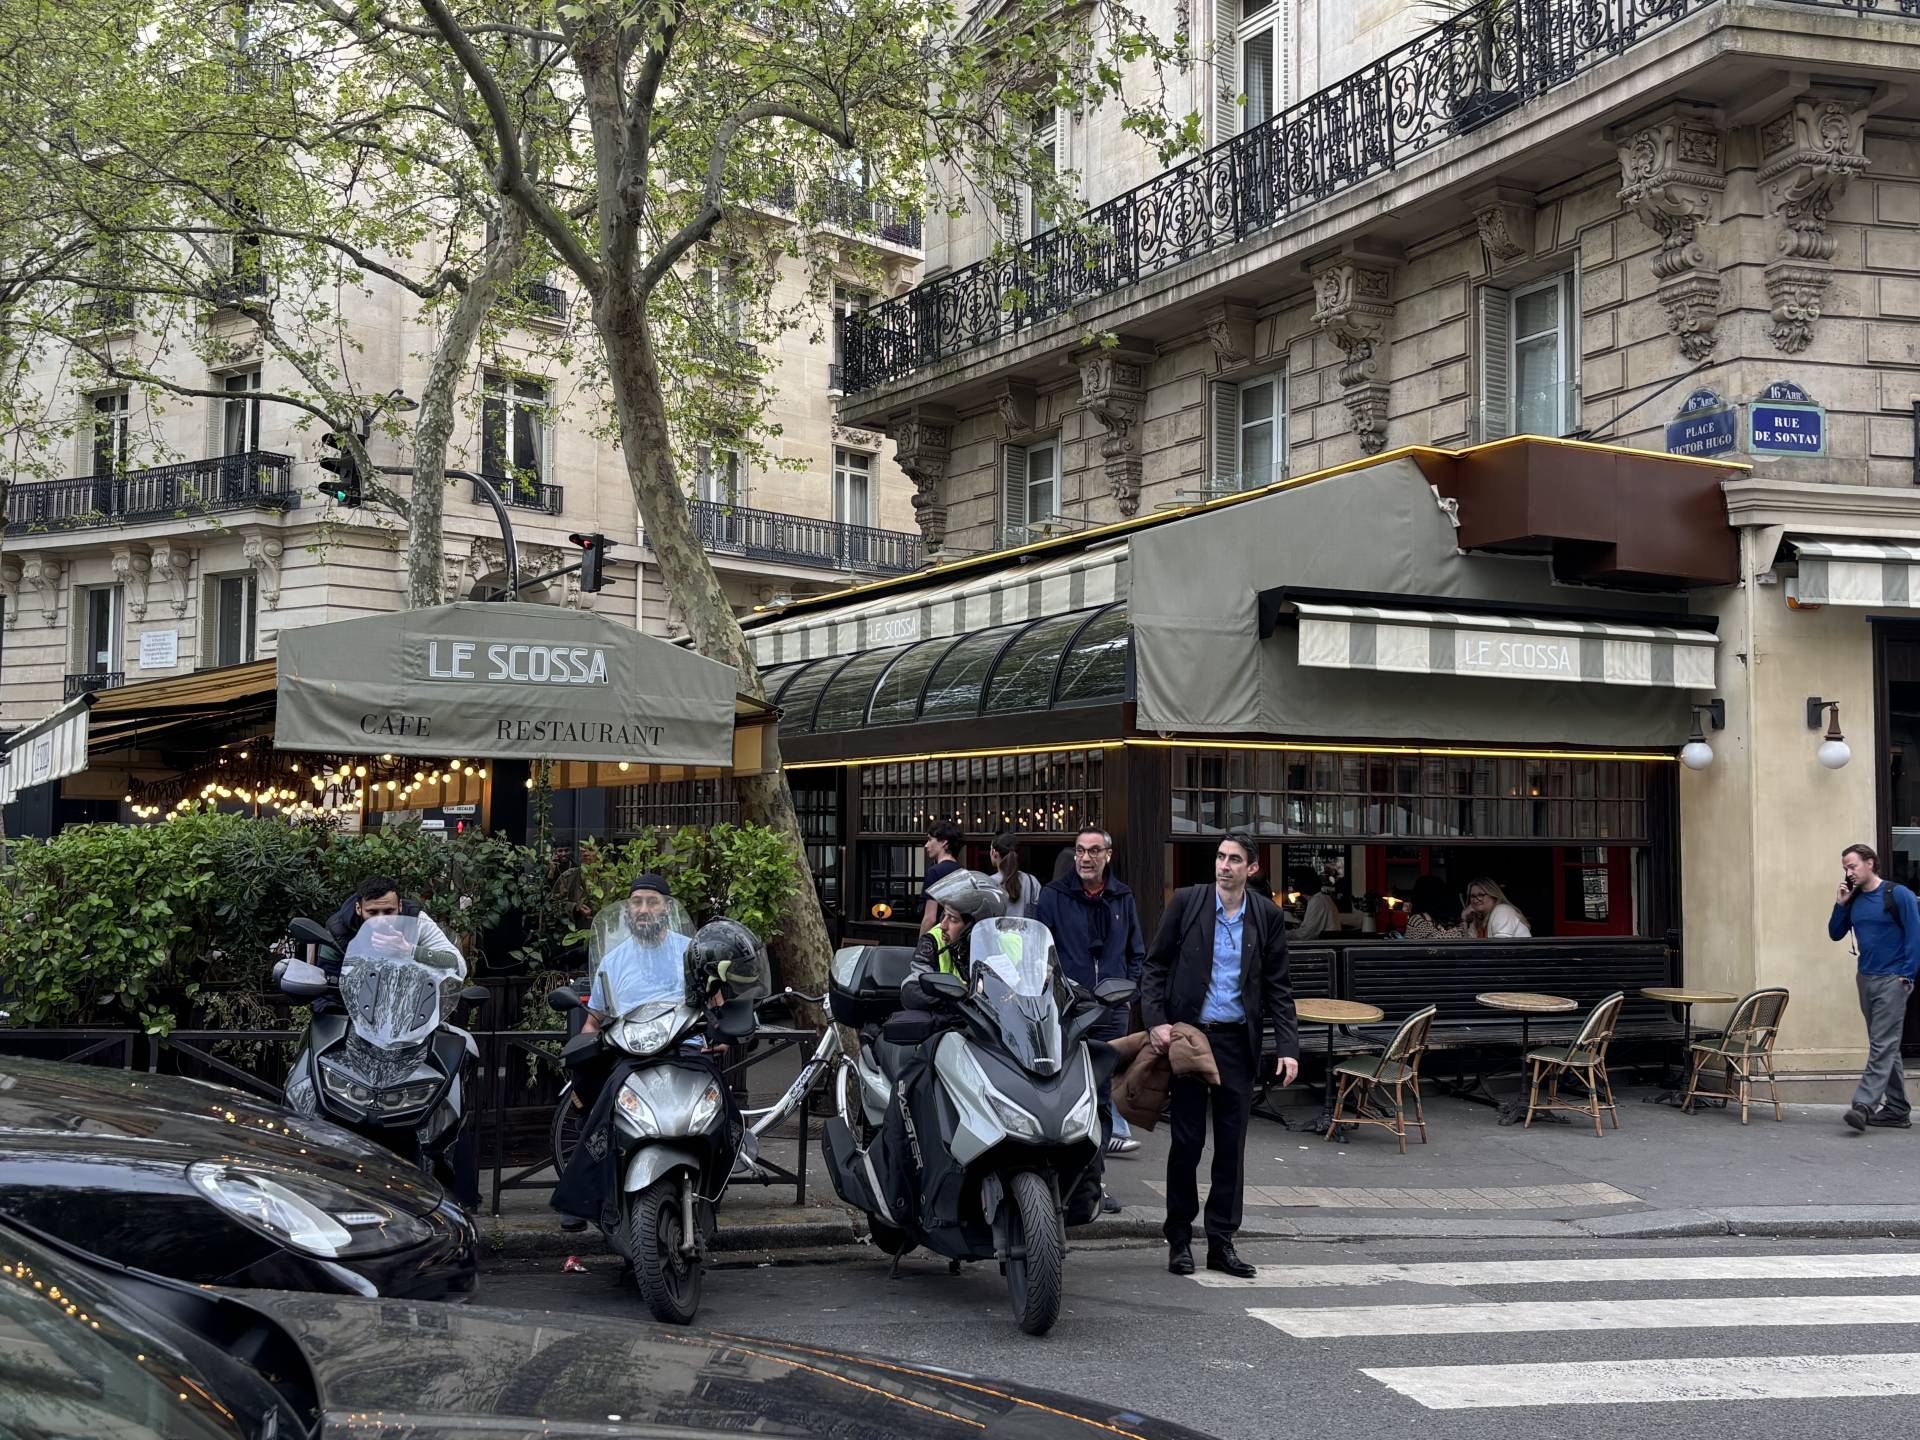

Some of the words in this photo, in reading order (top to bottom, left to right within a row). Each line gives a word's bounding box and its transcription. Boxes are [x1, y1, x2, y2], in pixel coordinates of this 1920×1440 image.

[1686, 422, 1715, 438] PLACE
[1774, 416, 1800, 428] RUE
[1705, 433, 1732, 449] HUGO
[1755, 430, 1771, 442] DE
[1774, 432, 1818, 445] SONTAY
[869, 623, 882, 642] LE
[429, 641, 476, 678] LE
[487, 644, 608, 685] SCOSSA
[1464, 639, 1492, 666] LE
[1499, 642, 1571, 671] SCOSSA
[497, 719, 665, 746] RESTAURANT
[898, 1080, 923, 1170] BAGSTER
